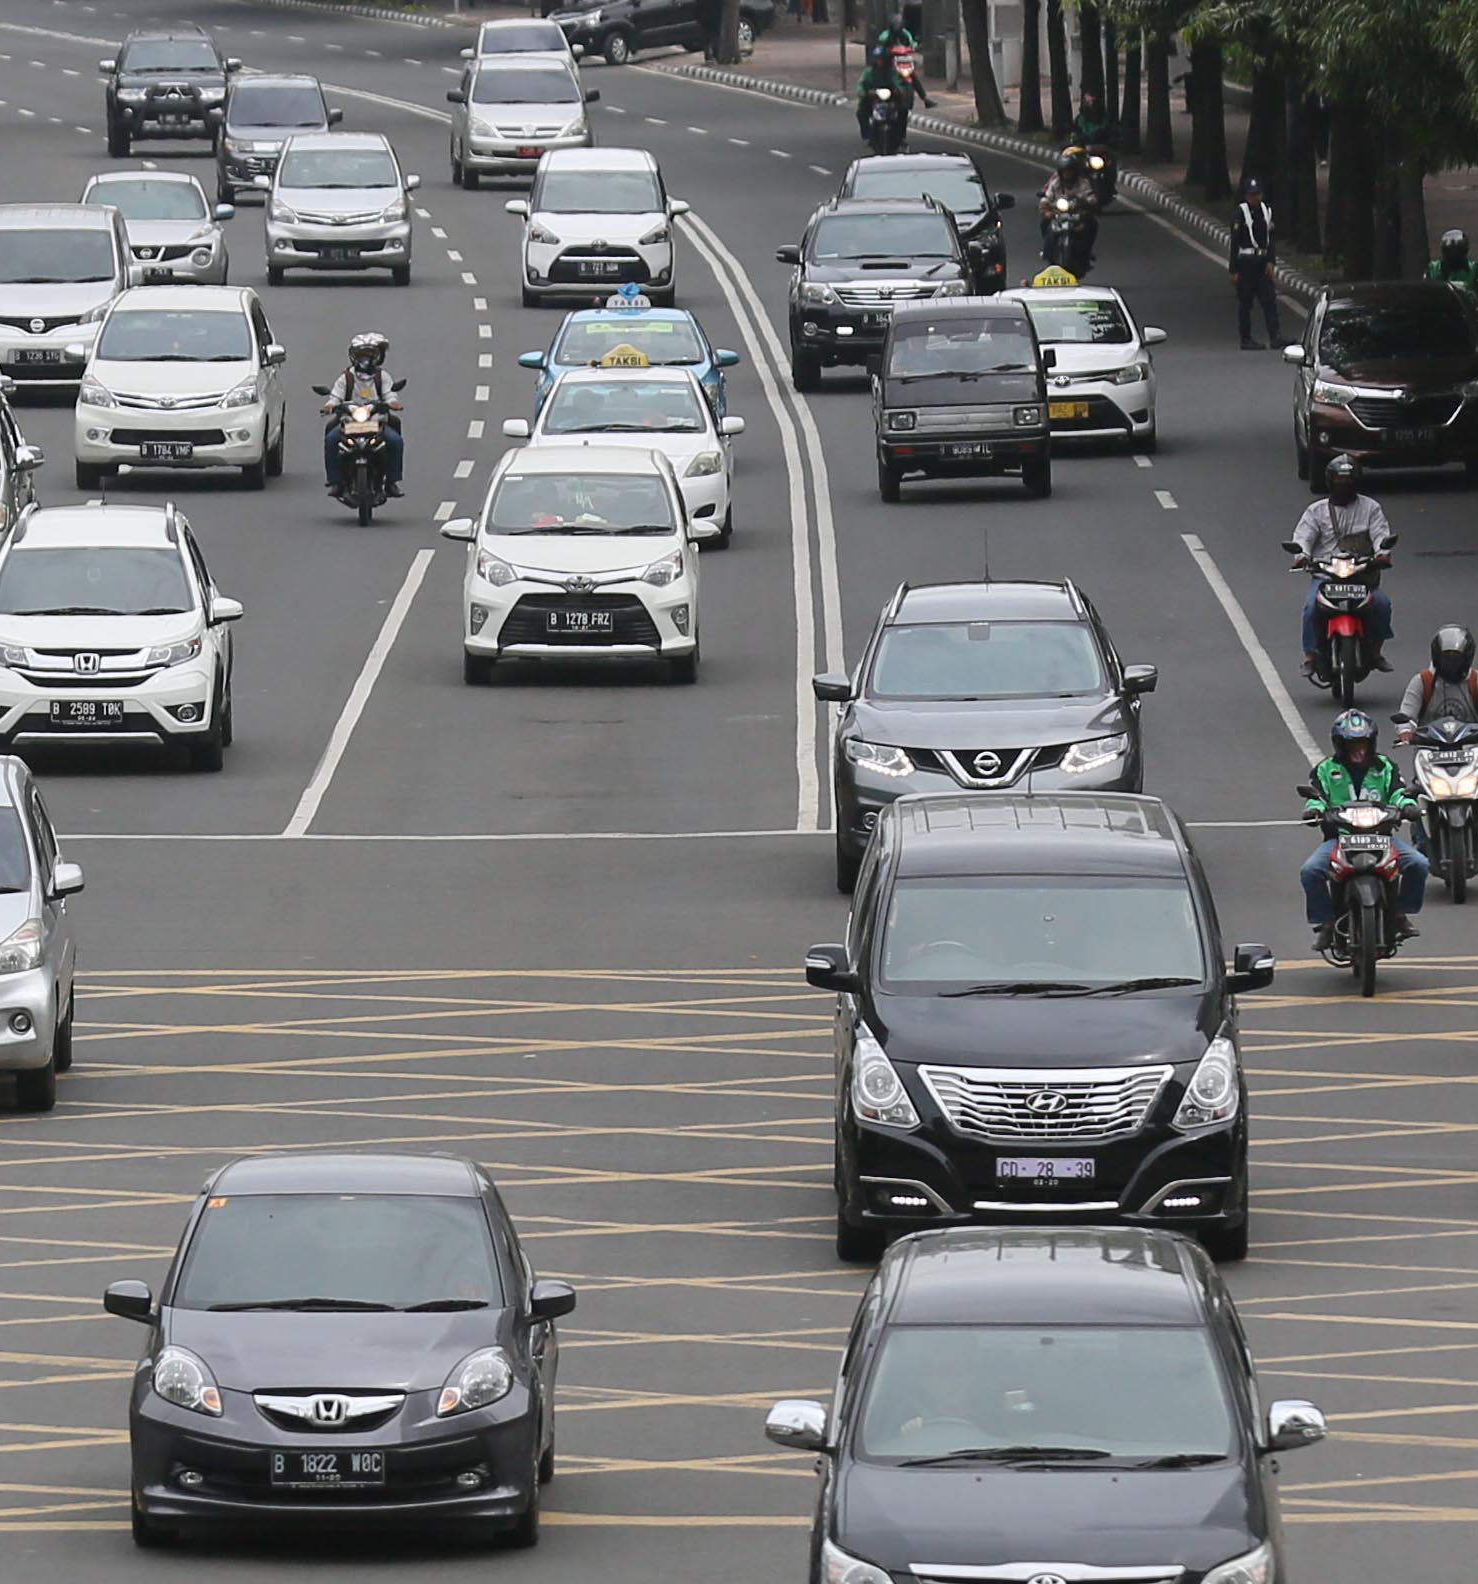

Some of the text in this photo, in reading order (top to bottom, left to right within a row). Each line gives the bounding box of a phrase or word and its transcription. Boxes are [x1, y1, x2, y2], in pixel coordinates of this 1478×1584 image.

[1042, 277, 1070, 286] TAKSI
[610, 357, 641, 365] TAKSI
[551, 613, 610, 625] B 1278 FRZ
[52, 702, 60, 715] B
[70, 702, 96, 716] 2589
[1000, 1161, 1093, 1178] CD 28 39
[274, 1454, 285, 1473] B
[301, 1454, 337, 1473] 1822
